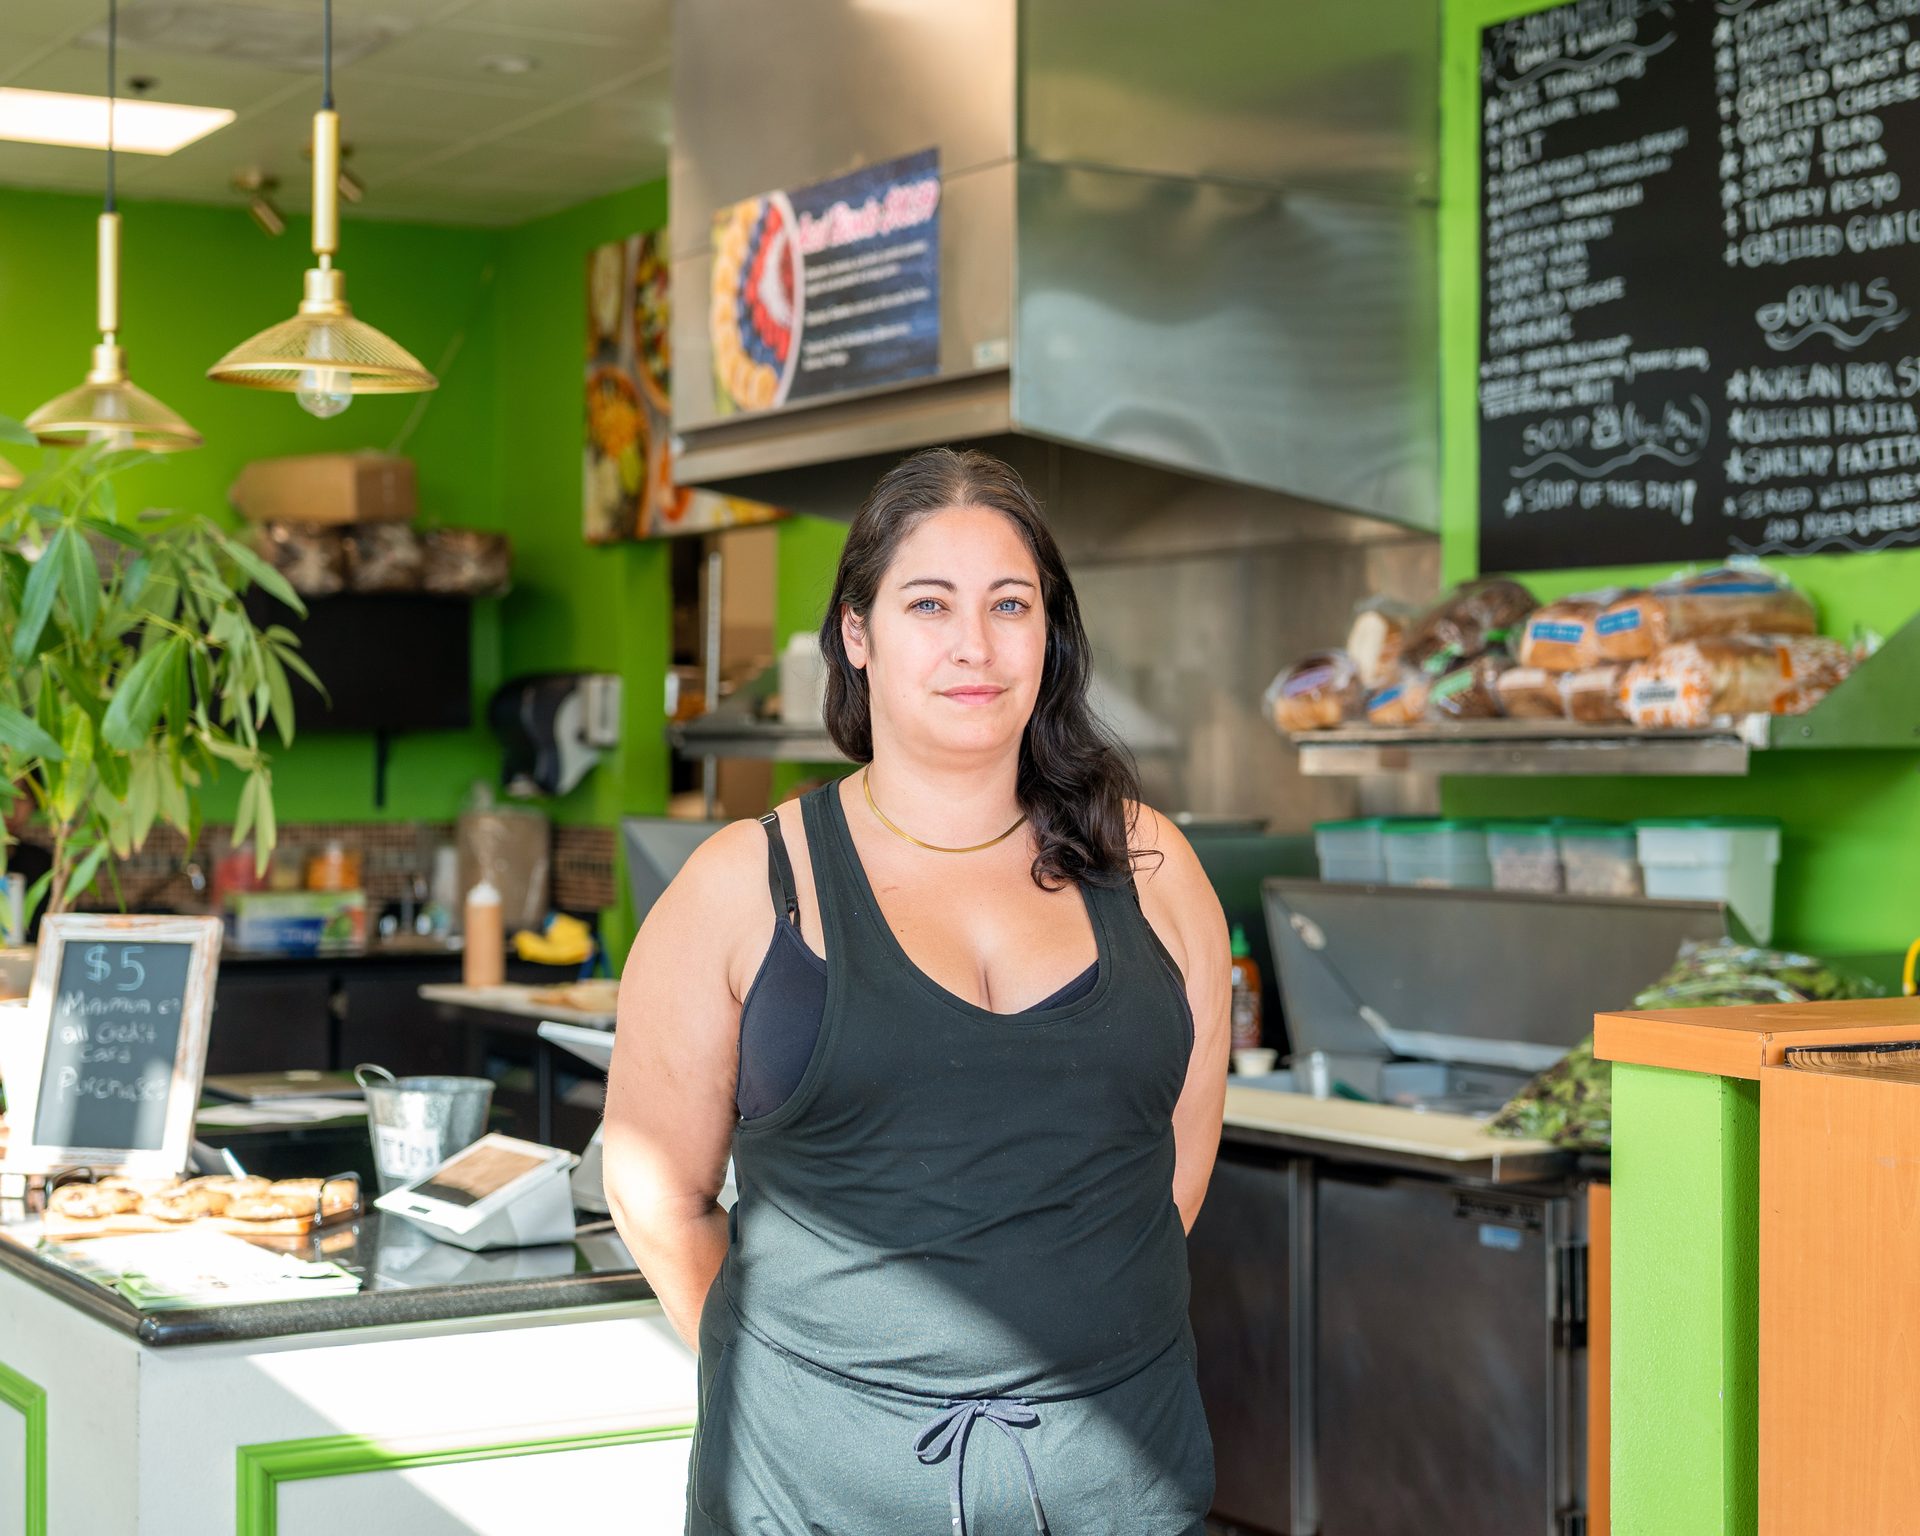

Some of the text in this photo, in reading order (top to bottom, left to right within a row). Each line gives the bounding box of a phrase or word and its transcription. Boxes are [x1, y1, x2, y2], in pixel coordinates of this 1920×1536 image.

[1741, 224, 1843, 267] GRILLED
[1787, 276, 1897, 327] BOWLS
[1750, 363, 1842, 401] KOREAN
[1523, 415, 1589, 456] SOUP
[1522, 478, 1578, 513] SOUP
[1580, 480, 1605, 509] OF
[1606, 480, 1645, 509] THE
[83, 943, 146, 992] $5
